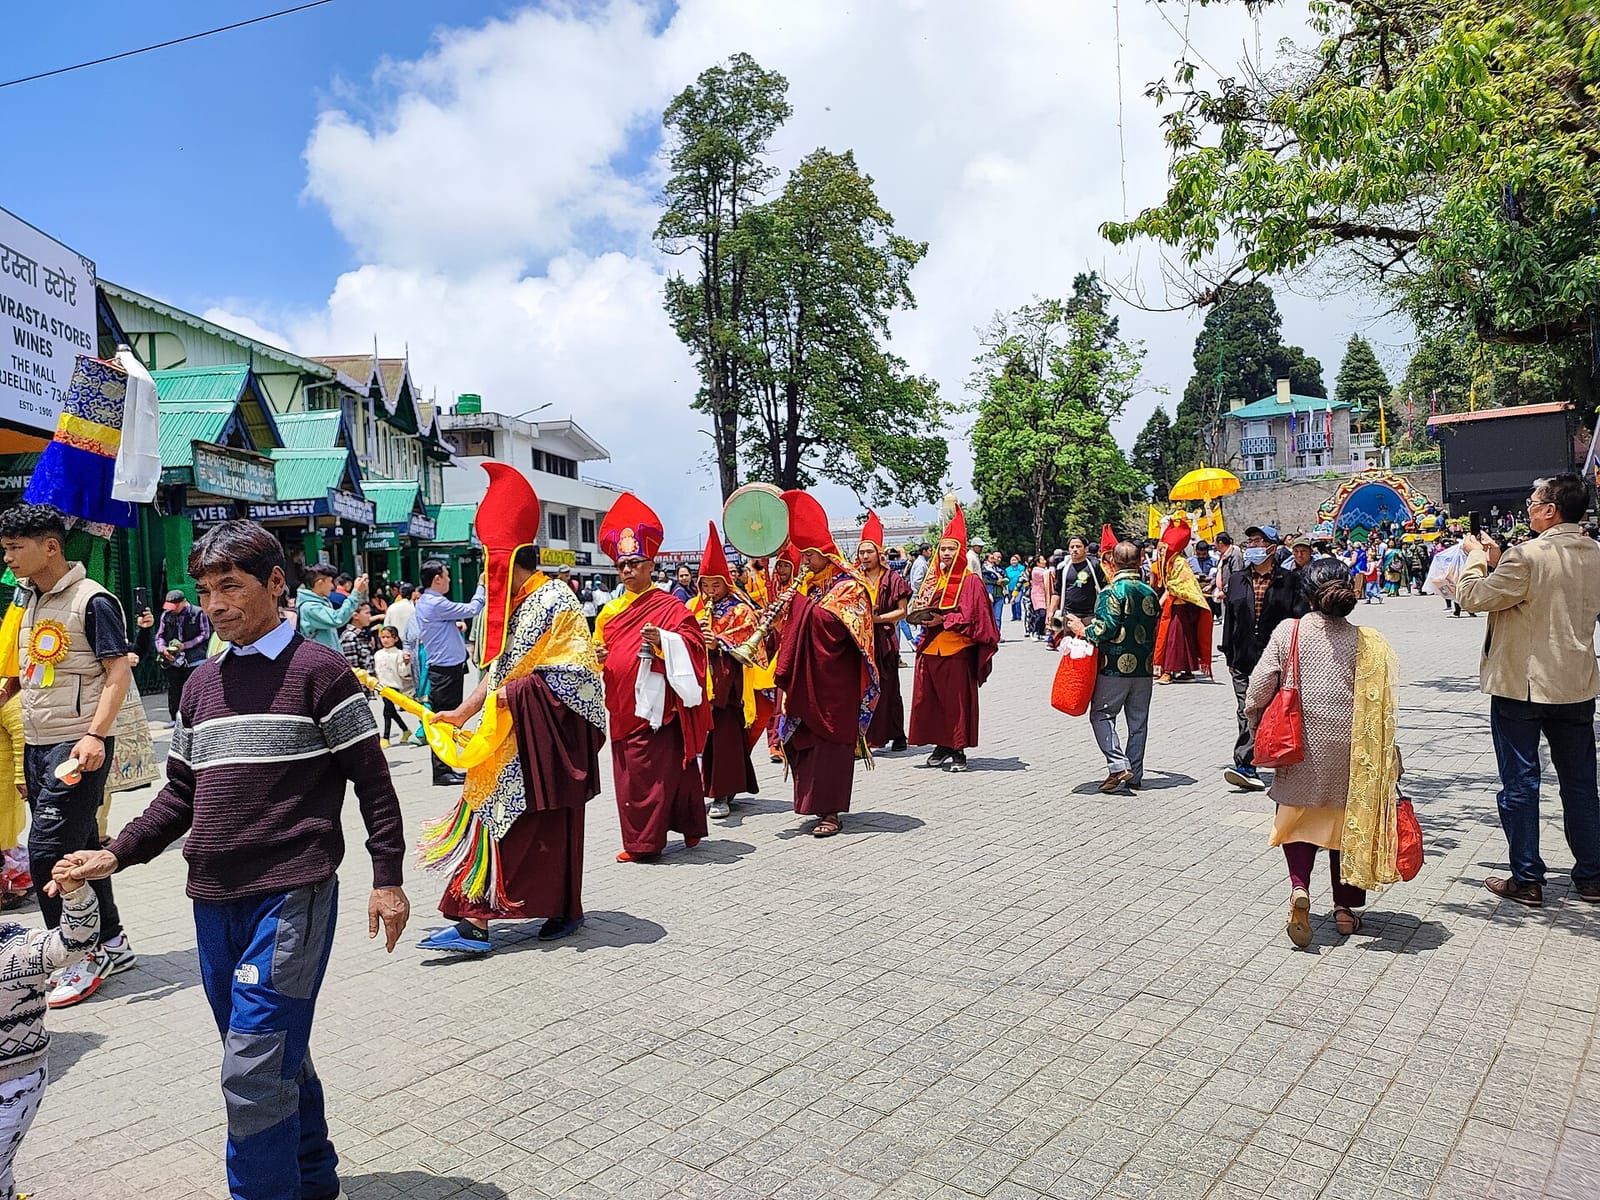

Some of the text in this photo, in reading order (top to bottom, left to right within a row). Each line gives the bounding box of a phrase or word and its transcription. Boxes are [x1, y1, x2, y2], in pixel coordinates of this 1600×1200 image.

[13, 326, 53, 358] WINES
[51, 318, 91, 351] STORES
[11, 355, 56, 384] THE MALL
[19, 400, 34, 412] ESTD
[192, 506, 228, 521] LVER
[248, 500, 316, 517] EWELLERY
